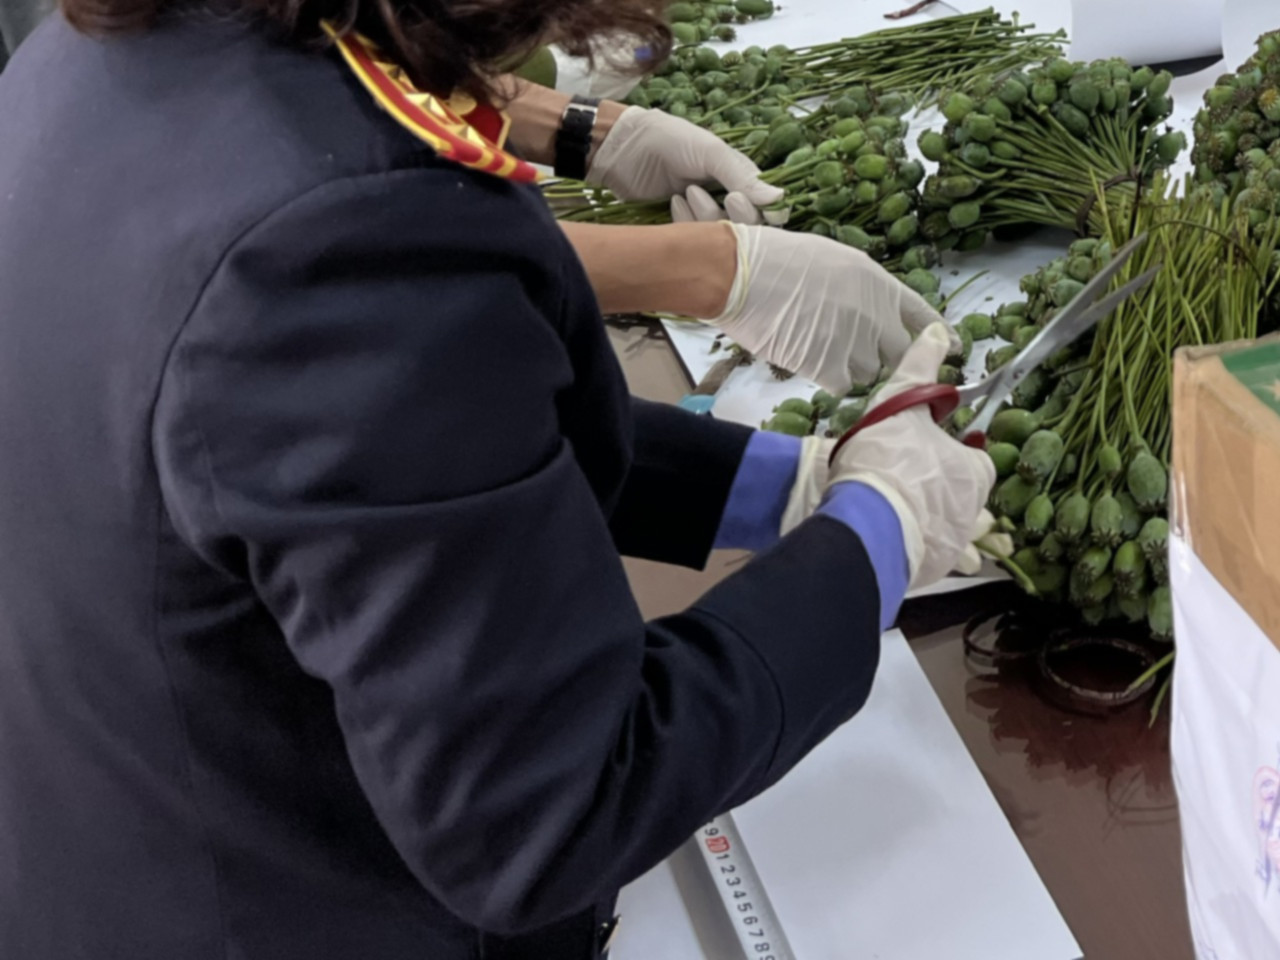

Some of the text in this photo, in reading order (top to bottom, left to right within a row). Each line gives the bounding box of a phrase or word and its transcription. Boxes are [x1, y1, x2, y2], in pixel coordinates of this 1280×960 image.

[704, 827, 719, 836] 9
[716, 853, 730, 861] 1
[720, 864, 736, 875] 2
[726, 876, 741, 887] 3
[733, 890, 747, 900] 4
[737, 902, 753, 913] 5
[743, 915, 759, 926] 6
[748, 928, 764, 939] 7
[754, 942, 770, 953] 8
